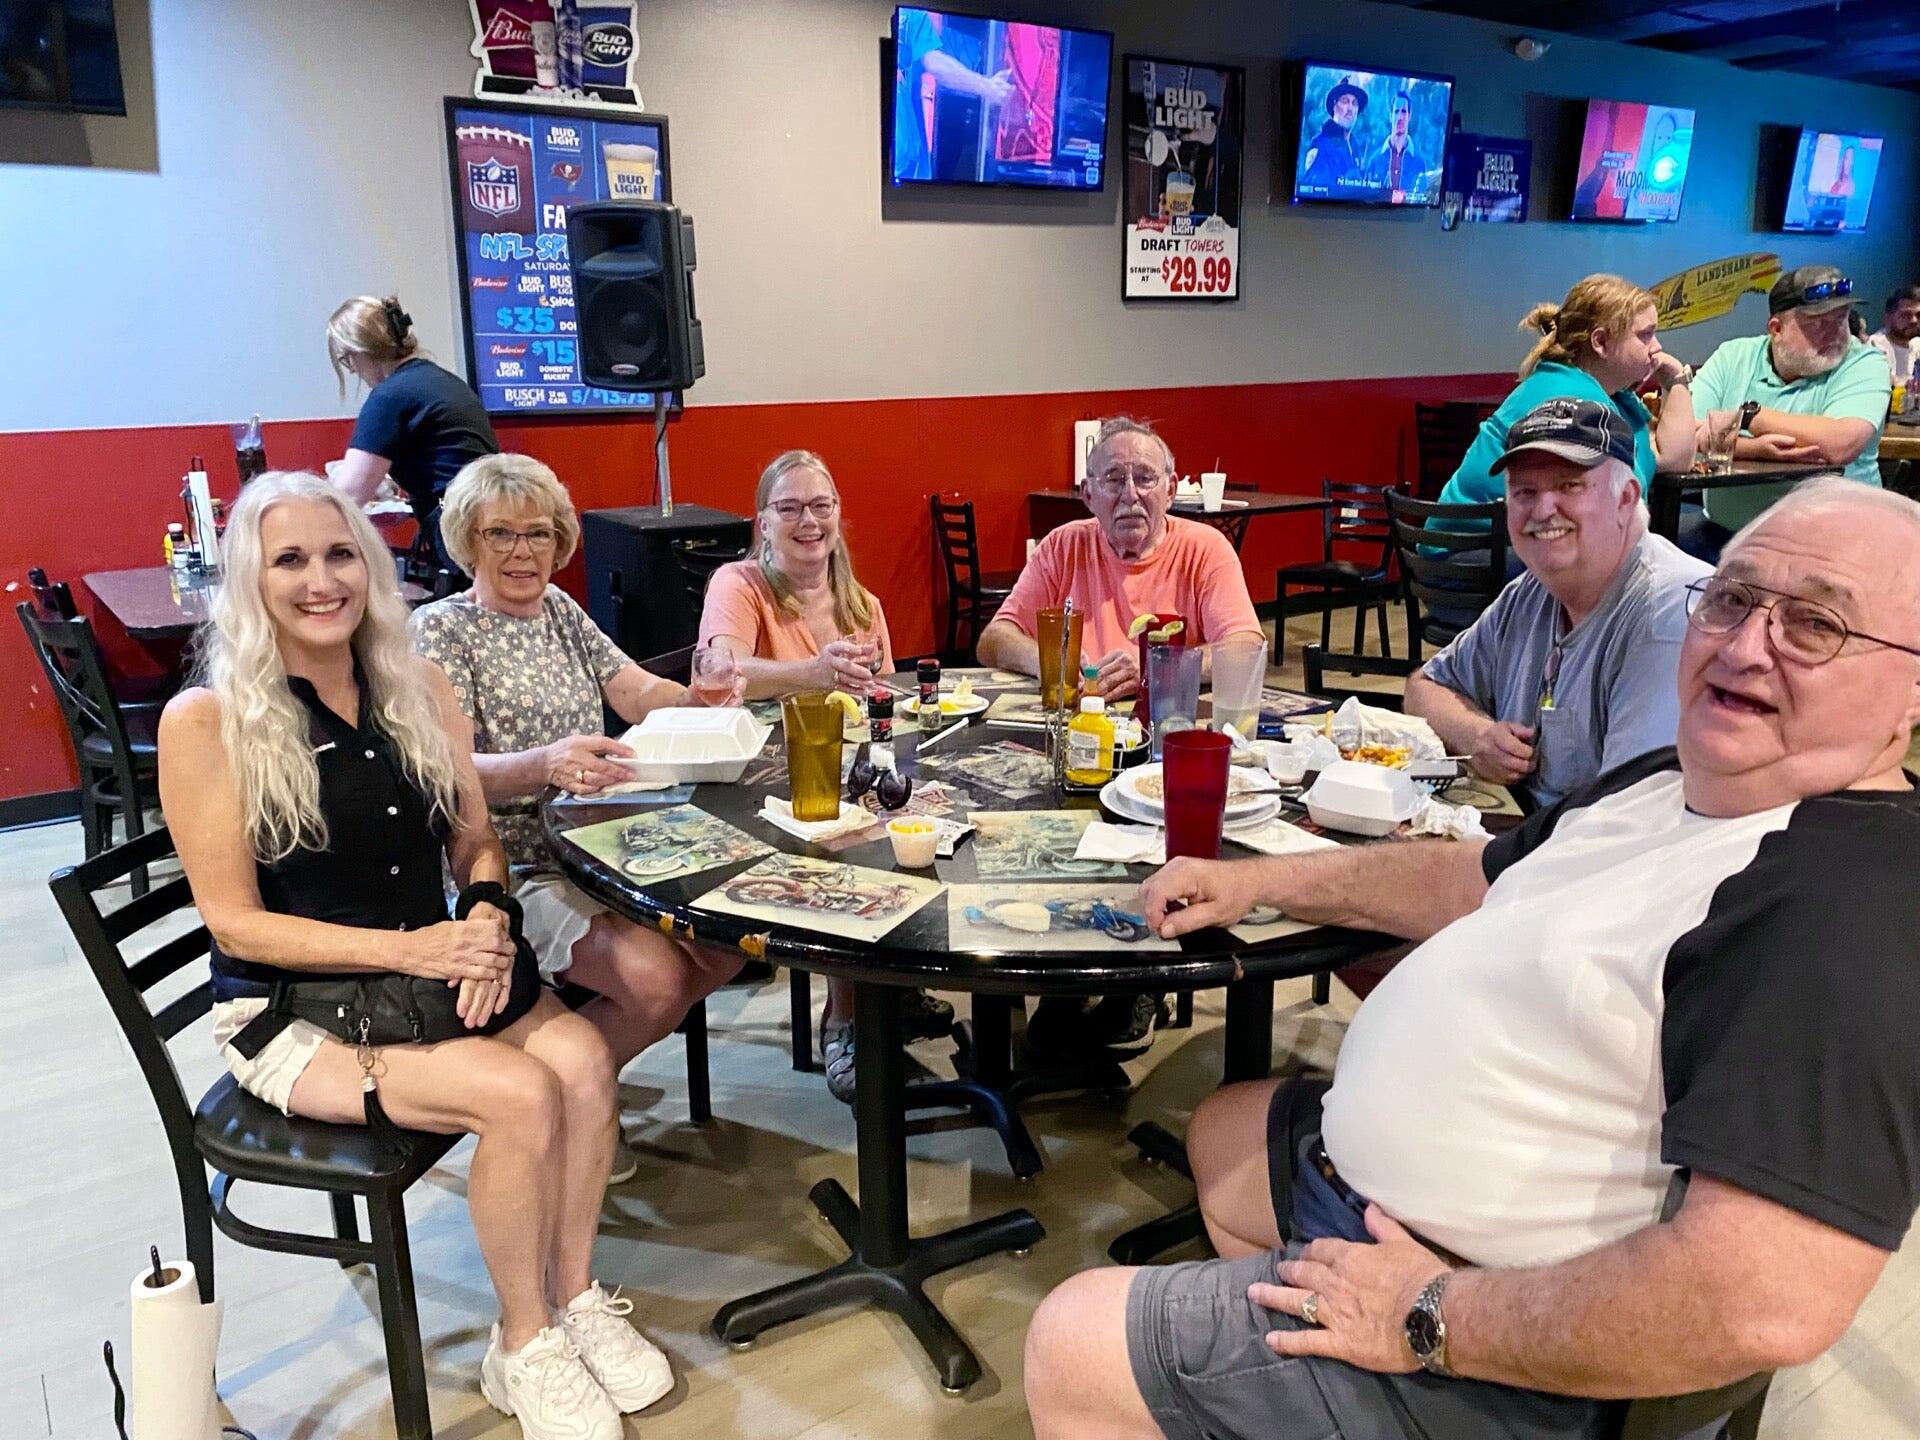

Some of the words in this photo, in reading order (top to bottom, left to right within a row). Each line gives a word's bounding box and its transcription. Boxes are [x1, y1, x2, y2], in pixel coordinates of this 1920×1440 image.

[592, 32, 626, 45] BUD
[585, 41, 631, 55] LIGHT
[1164, 87, 1207, 109] BUD
[1155, 106, 1215, 128] LIGHT
[550, 126, 575, 138] BUD
[546, 134, 580, 146] LIGHT
[1484, 152, 1514, 171] BUD
[617, 174, 645, 185] BUD
[1476, 170, 1519, 193] LIGHT
[614, 183, 648, 195] LIGHT
[477, 184, 514, 209] NFL
[543, 204, 571, 229] FA
[1175, 217, 1192, 226] BUD
[1173, 225, 1195, 234] LIGHT
[480, 232, 533, 261] NFL
[536, 233, 569, 260] SP
[1141, 239, 1180, 251] DRAFT
[1184, 239, 1225, 253] TOWERS
[524, 262, 571, 271] SATURDA
[1696, 256, 1752, 286] LANDSHARK
[521, 276, 541, 284] BUD
[1162, 256, 1232, 292] $29.99
[518, 283, 545, 293] LIGHT
[496, 307, 555, 333] $35
[560, 322, 577, 331] DO
[532, 340, 575, 364] $15
[496, 368, 525, 377] LIGHT
[499, 362, 520, 370] BUD
[543, 373, 571, 381] BUCKET
[504, 388, 546, 402] BUSCH
